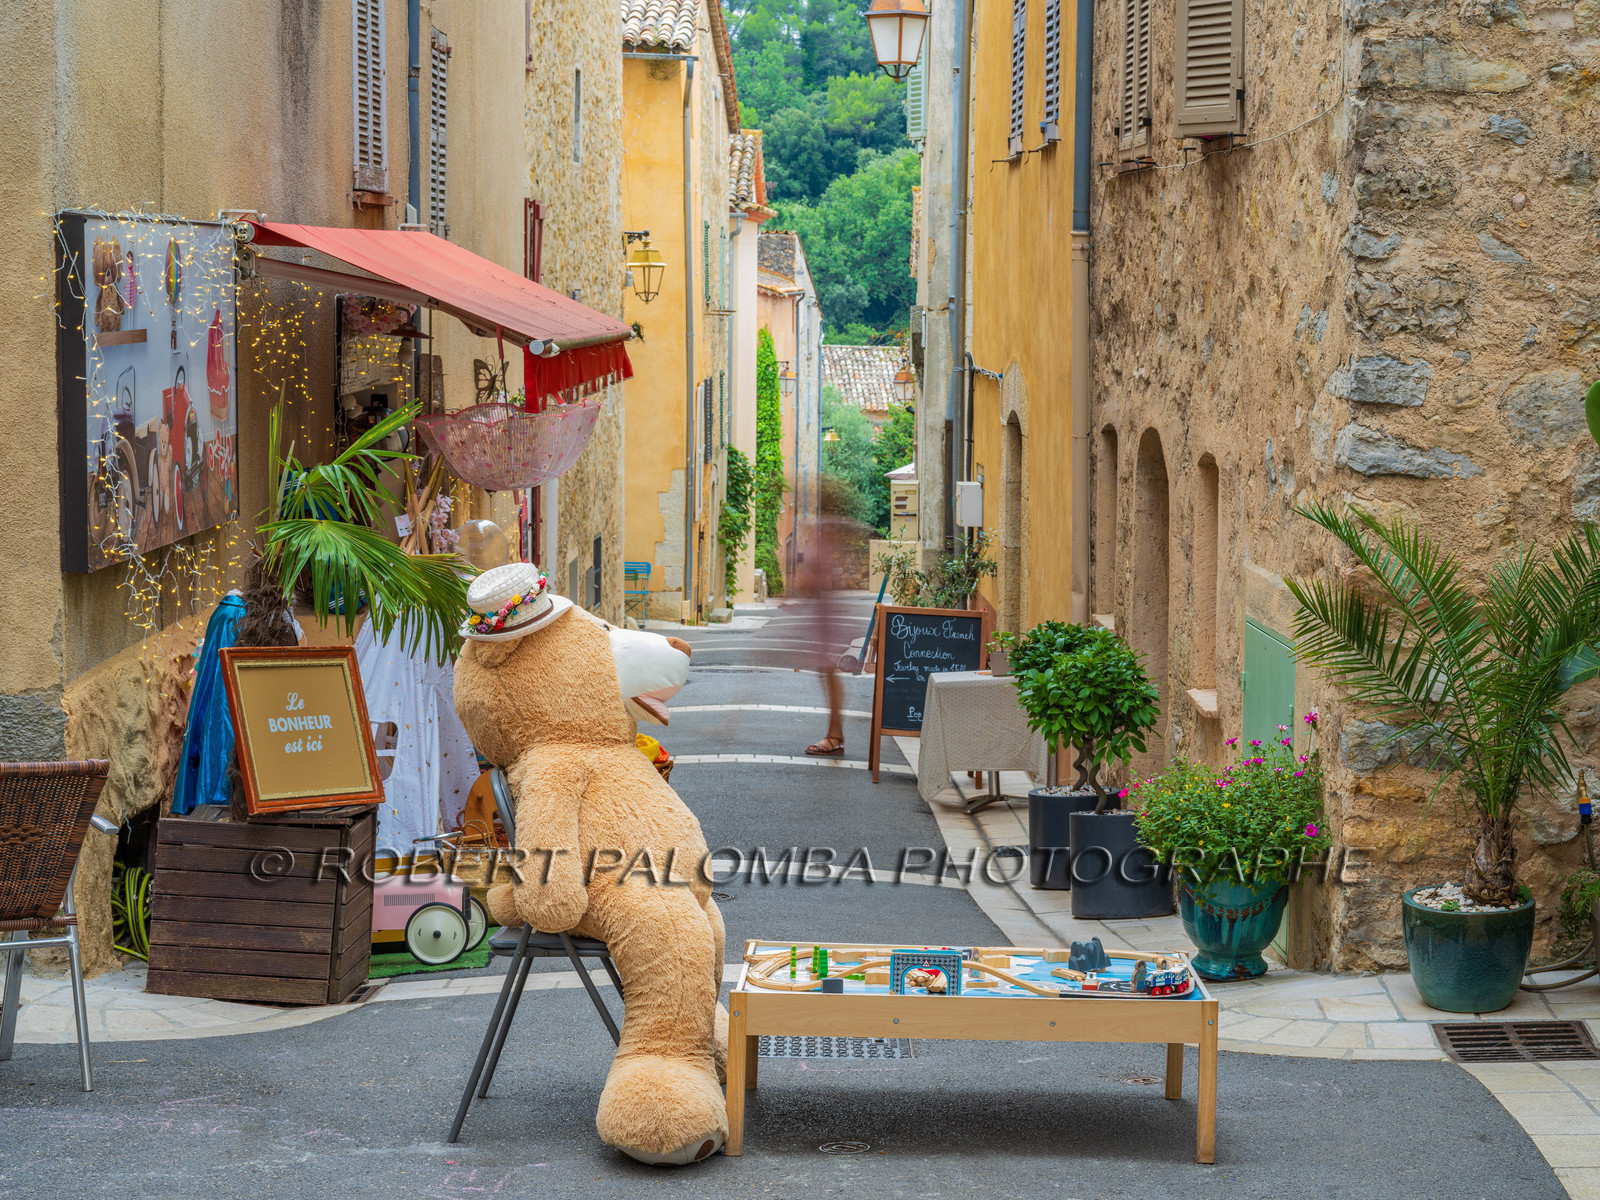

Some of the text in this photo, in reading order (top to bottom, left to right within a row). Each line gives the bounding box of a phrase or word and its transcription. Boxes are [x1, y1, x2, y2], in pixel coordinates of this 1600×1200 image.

[890, 614, 975, 645] Bijoux French
[903, 640, 956, 660] Connection
[285, 692, 305, 711] Le
[268, 714, 333, 733] BONHEUR
[284, 735, 323, 754] est ici
